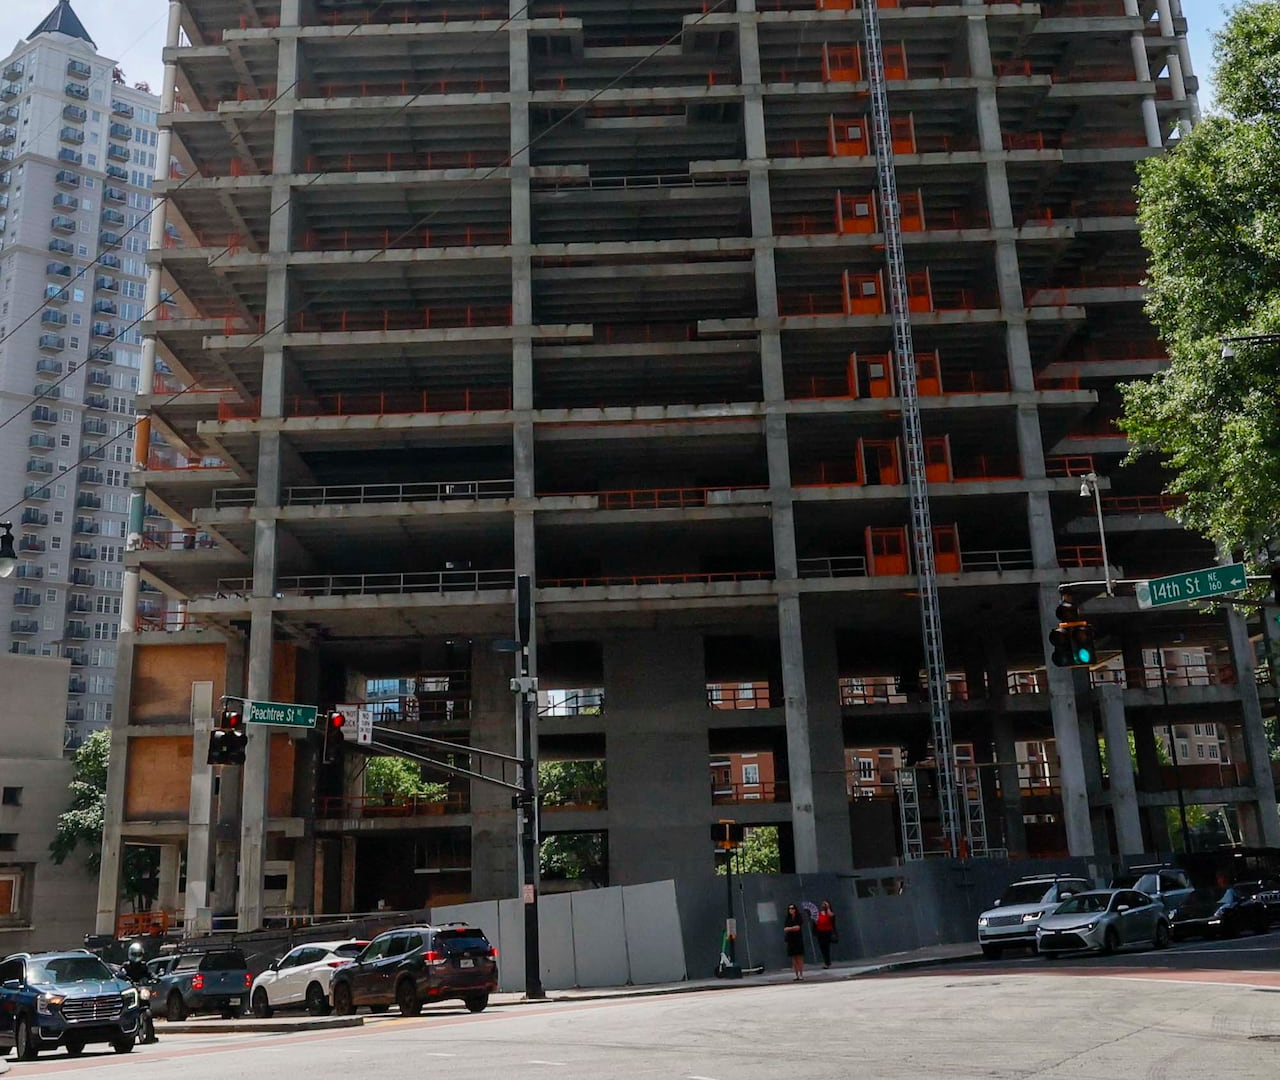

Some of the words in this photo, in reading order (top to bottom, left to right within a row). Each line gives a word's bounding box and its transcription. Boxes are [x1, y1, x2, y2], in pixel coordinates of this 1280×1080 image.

[1207, 572, 1217, 581] NE
[1153, 581, 1180, 600] 14th
[1185, 577, 1201, 594] St
[1208, 581, 1222, 591] 160
[250, 706, 284, 721] Peachtree
[287, 708, 294, 722] St
